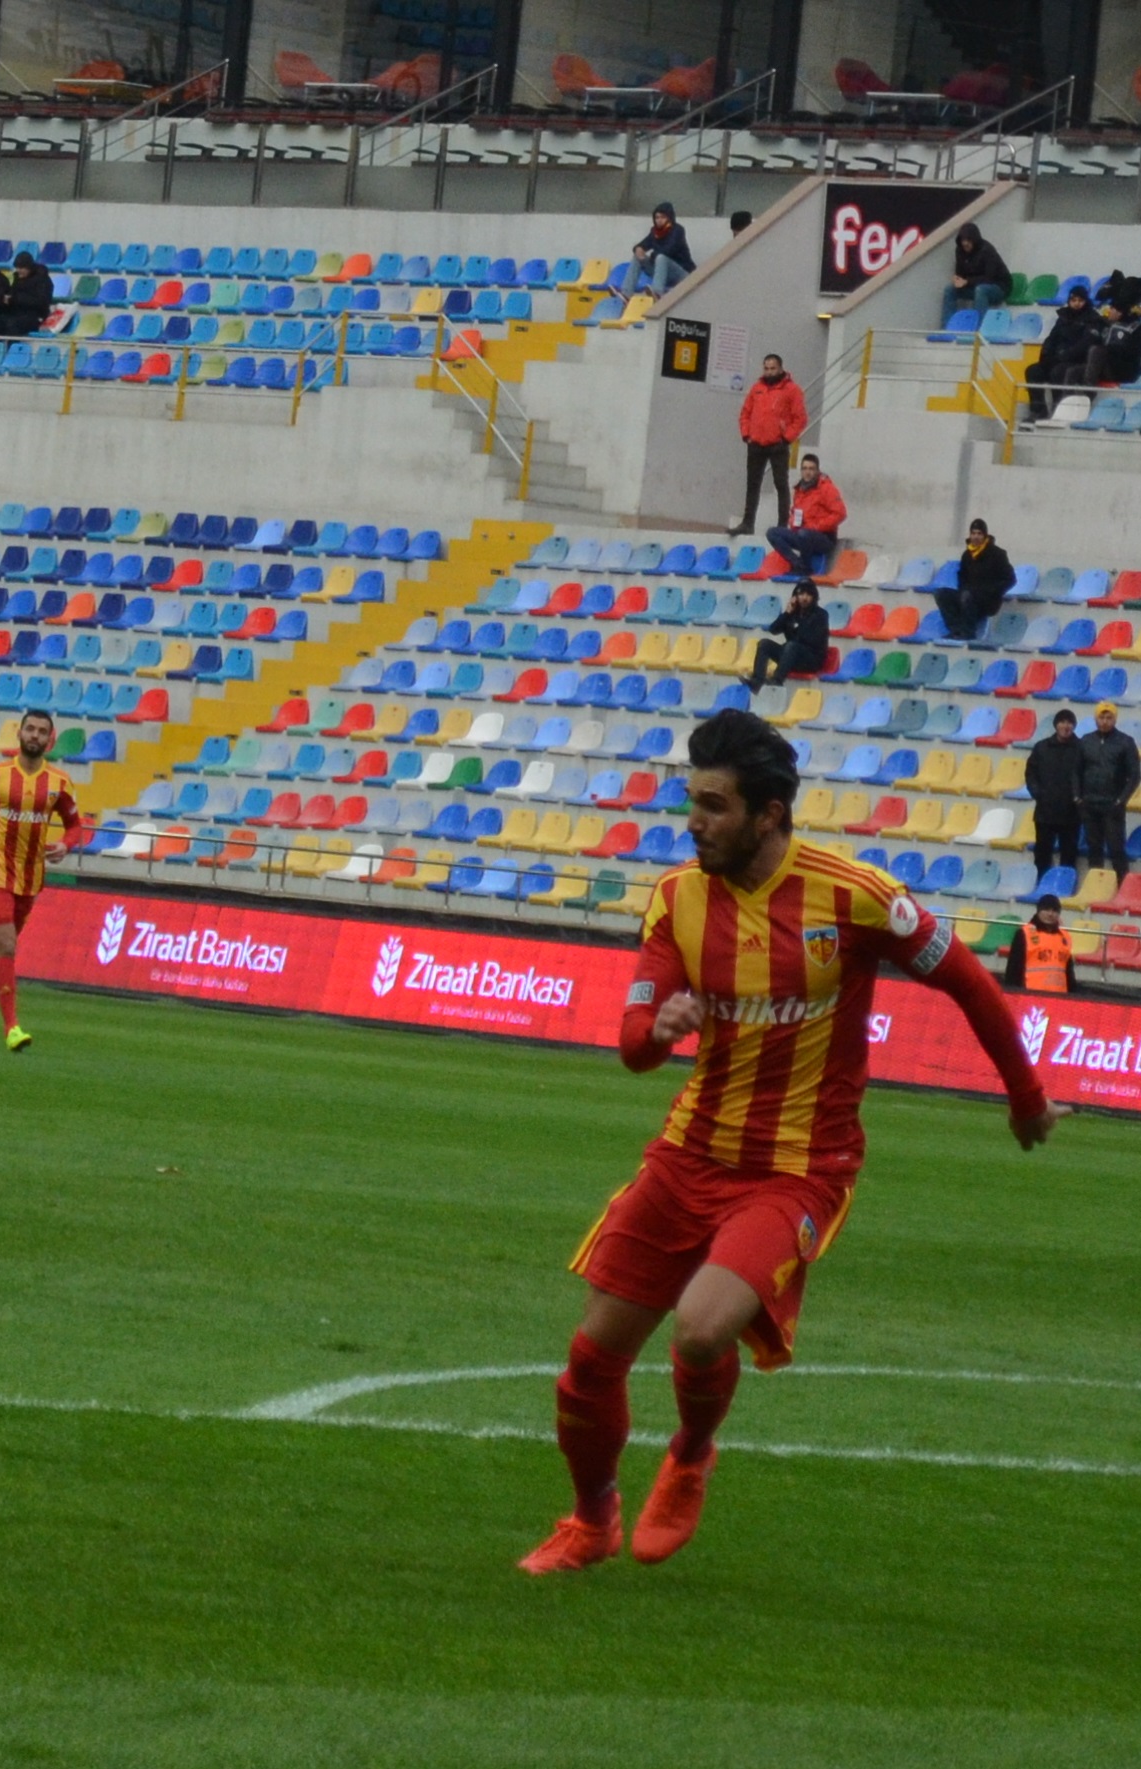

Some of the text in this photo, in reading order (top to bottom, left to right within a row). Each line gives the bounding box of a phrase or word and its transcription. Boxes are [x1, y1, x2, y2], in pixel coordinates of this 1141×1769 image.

[127, 921, 288, 973] Ziraat Bankası
[405, 952, 573, 1006] Ziraat Bankası
[1050, 1025, 1135, 1074] Ziraat
